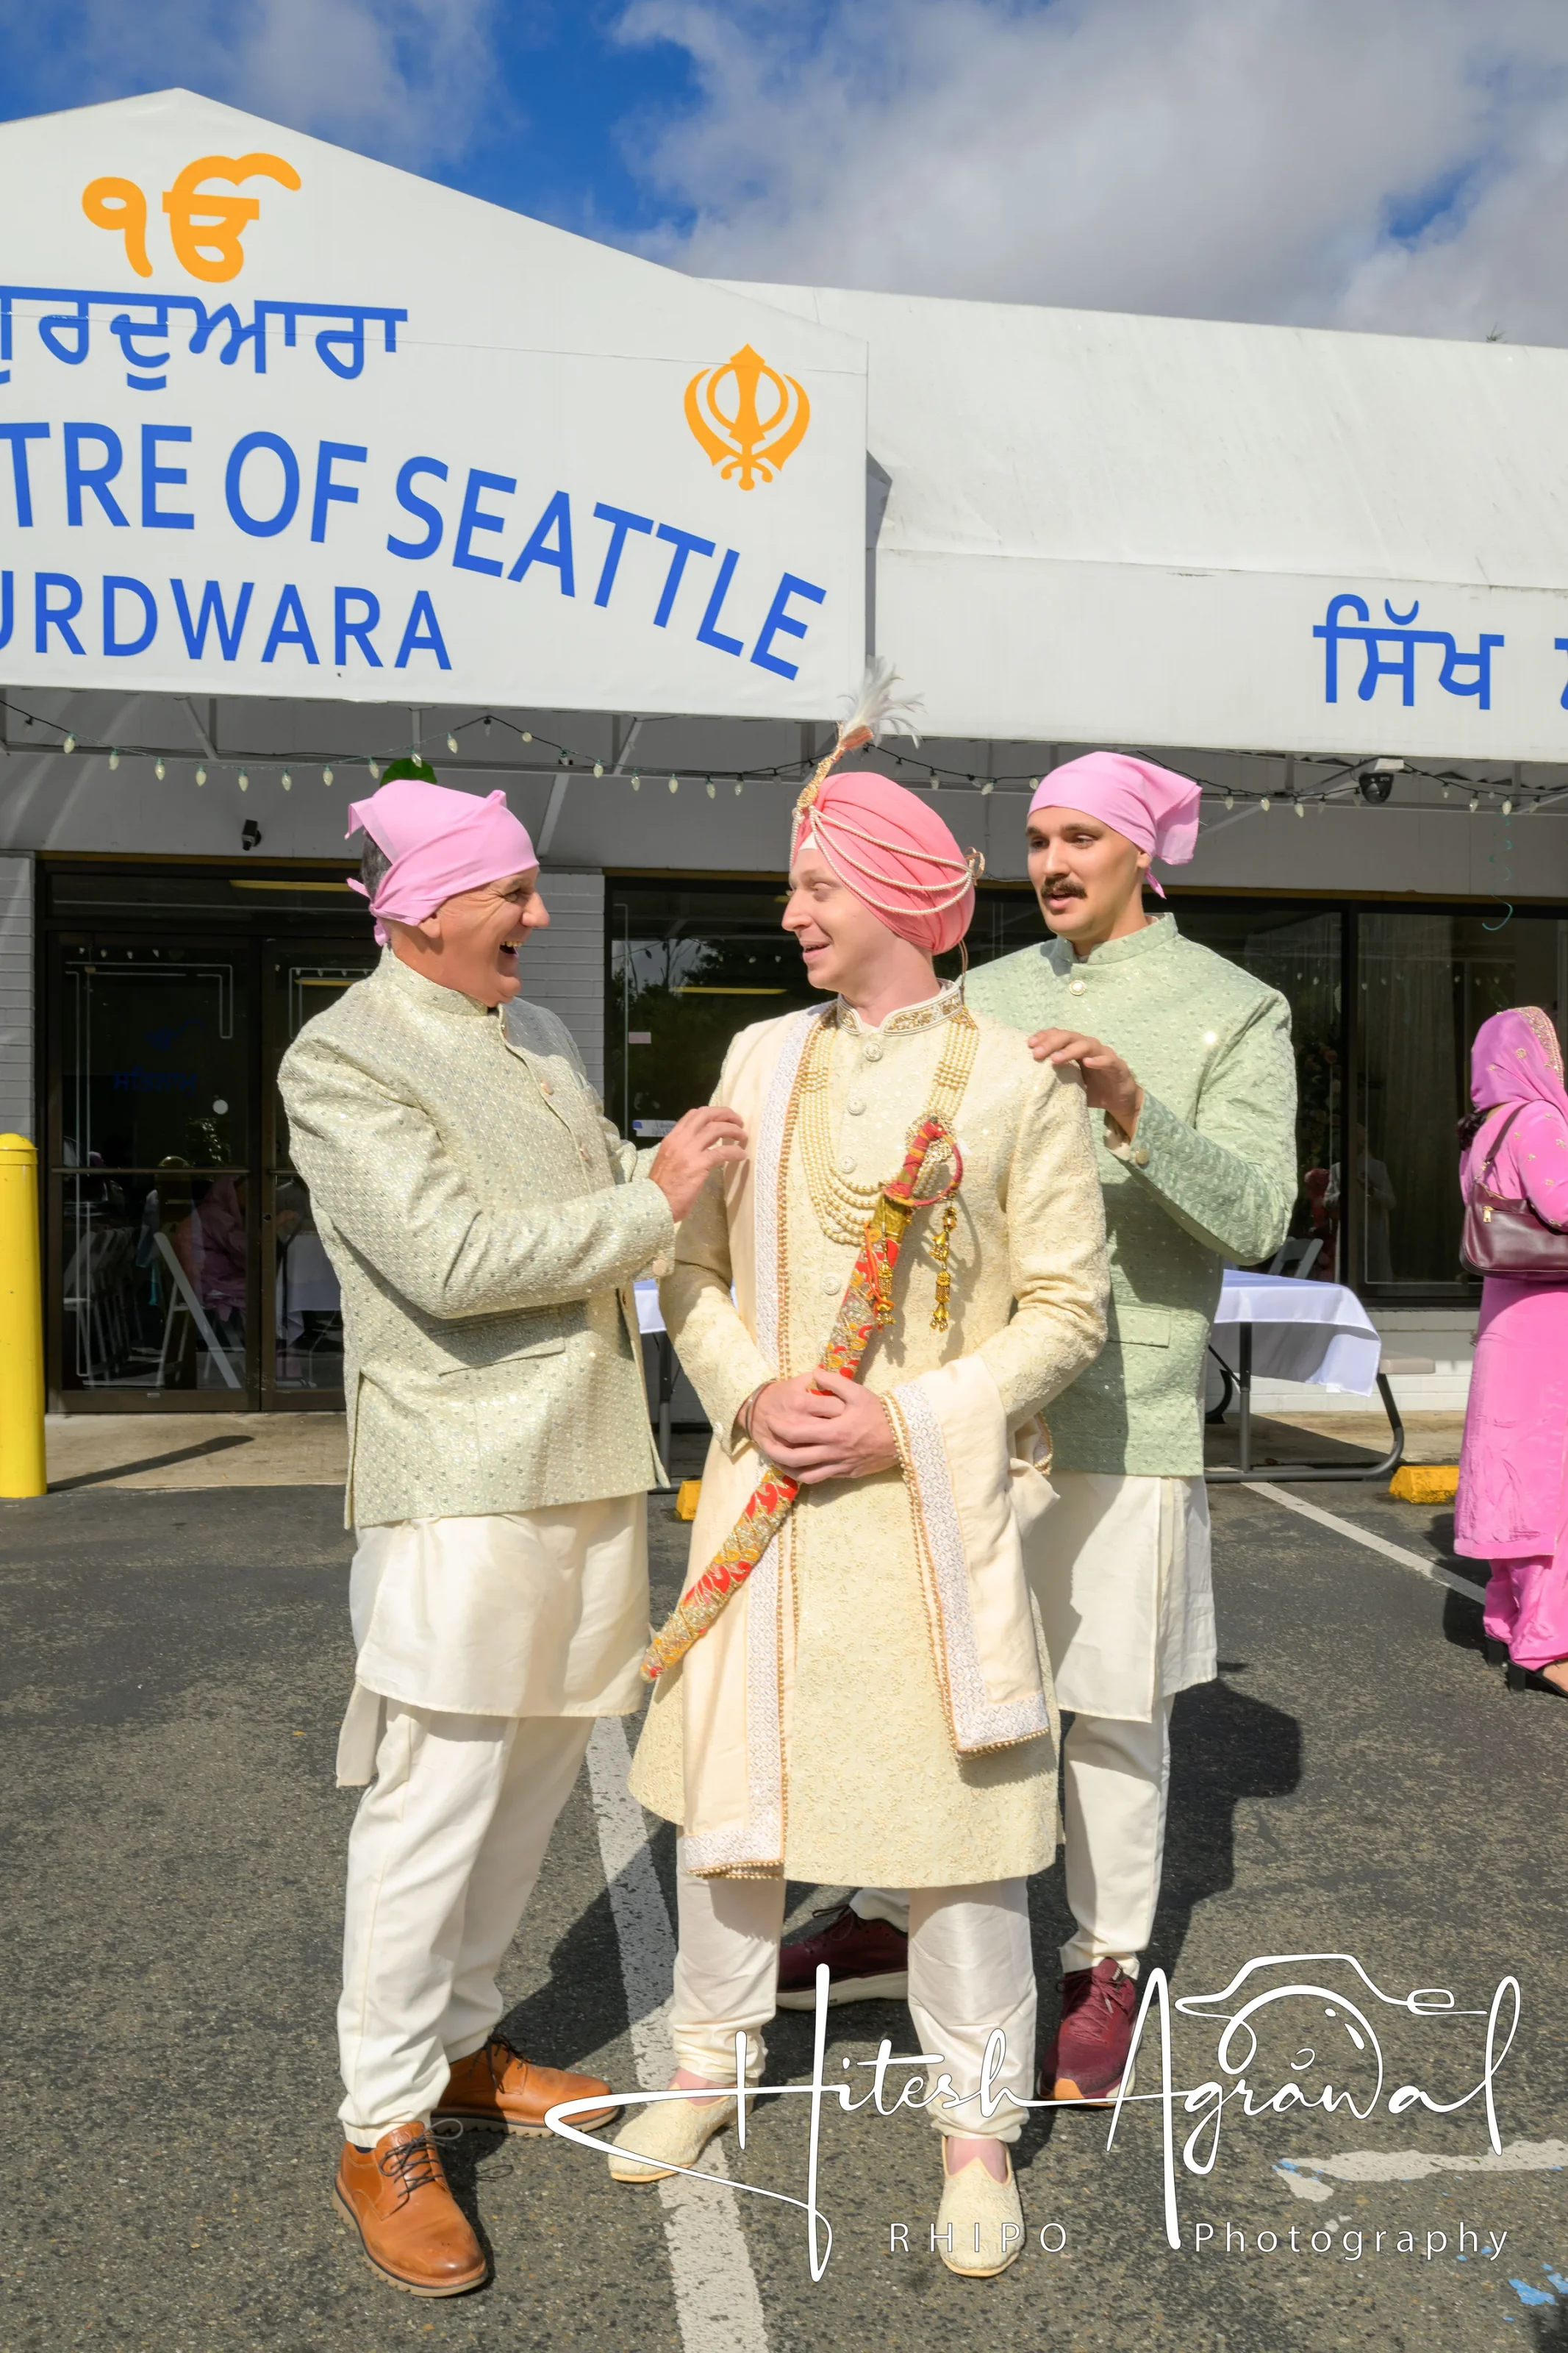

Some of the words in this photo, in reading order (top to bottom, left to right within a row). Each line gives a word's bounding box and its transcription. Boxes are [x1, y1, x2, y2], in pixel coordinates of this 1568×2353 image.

[0, 285, 407, 390] ਰਦੁਆਰਾ
[225, 432, 368, 543] OF
[387, 456, 827, 681] SEATTLE
[1312, 593, 1504, 710] ਸਿੱਖ
